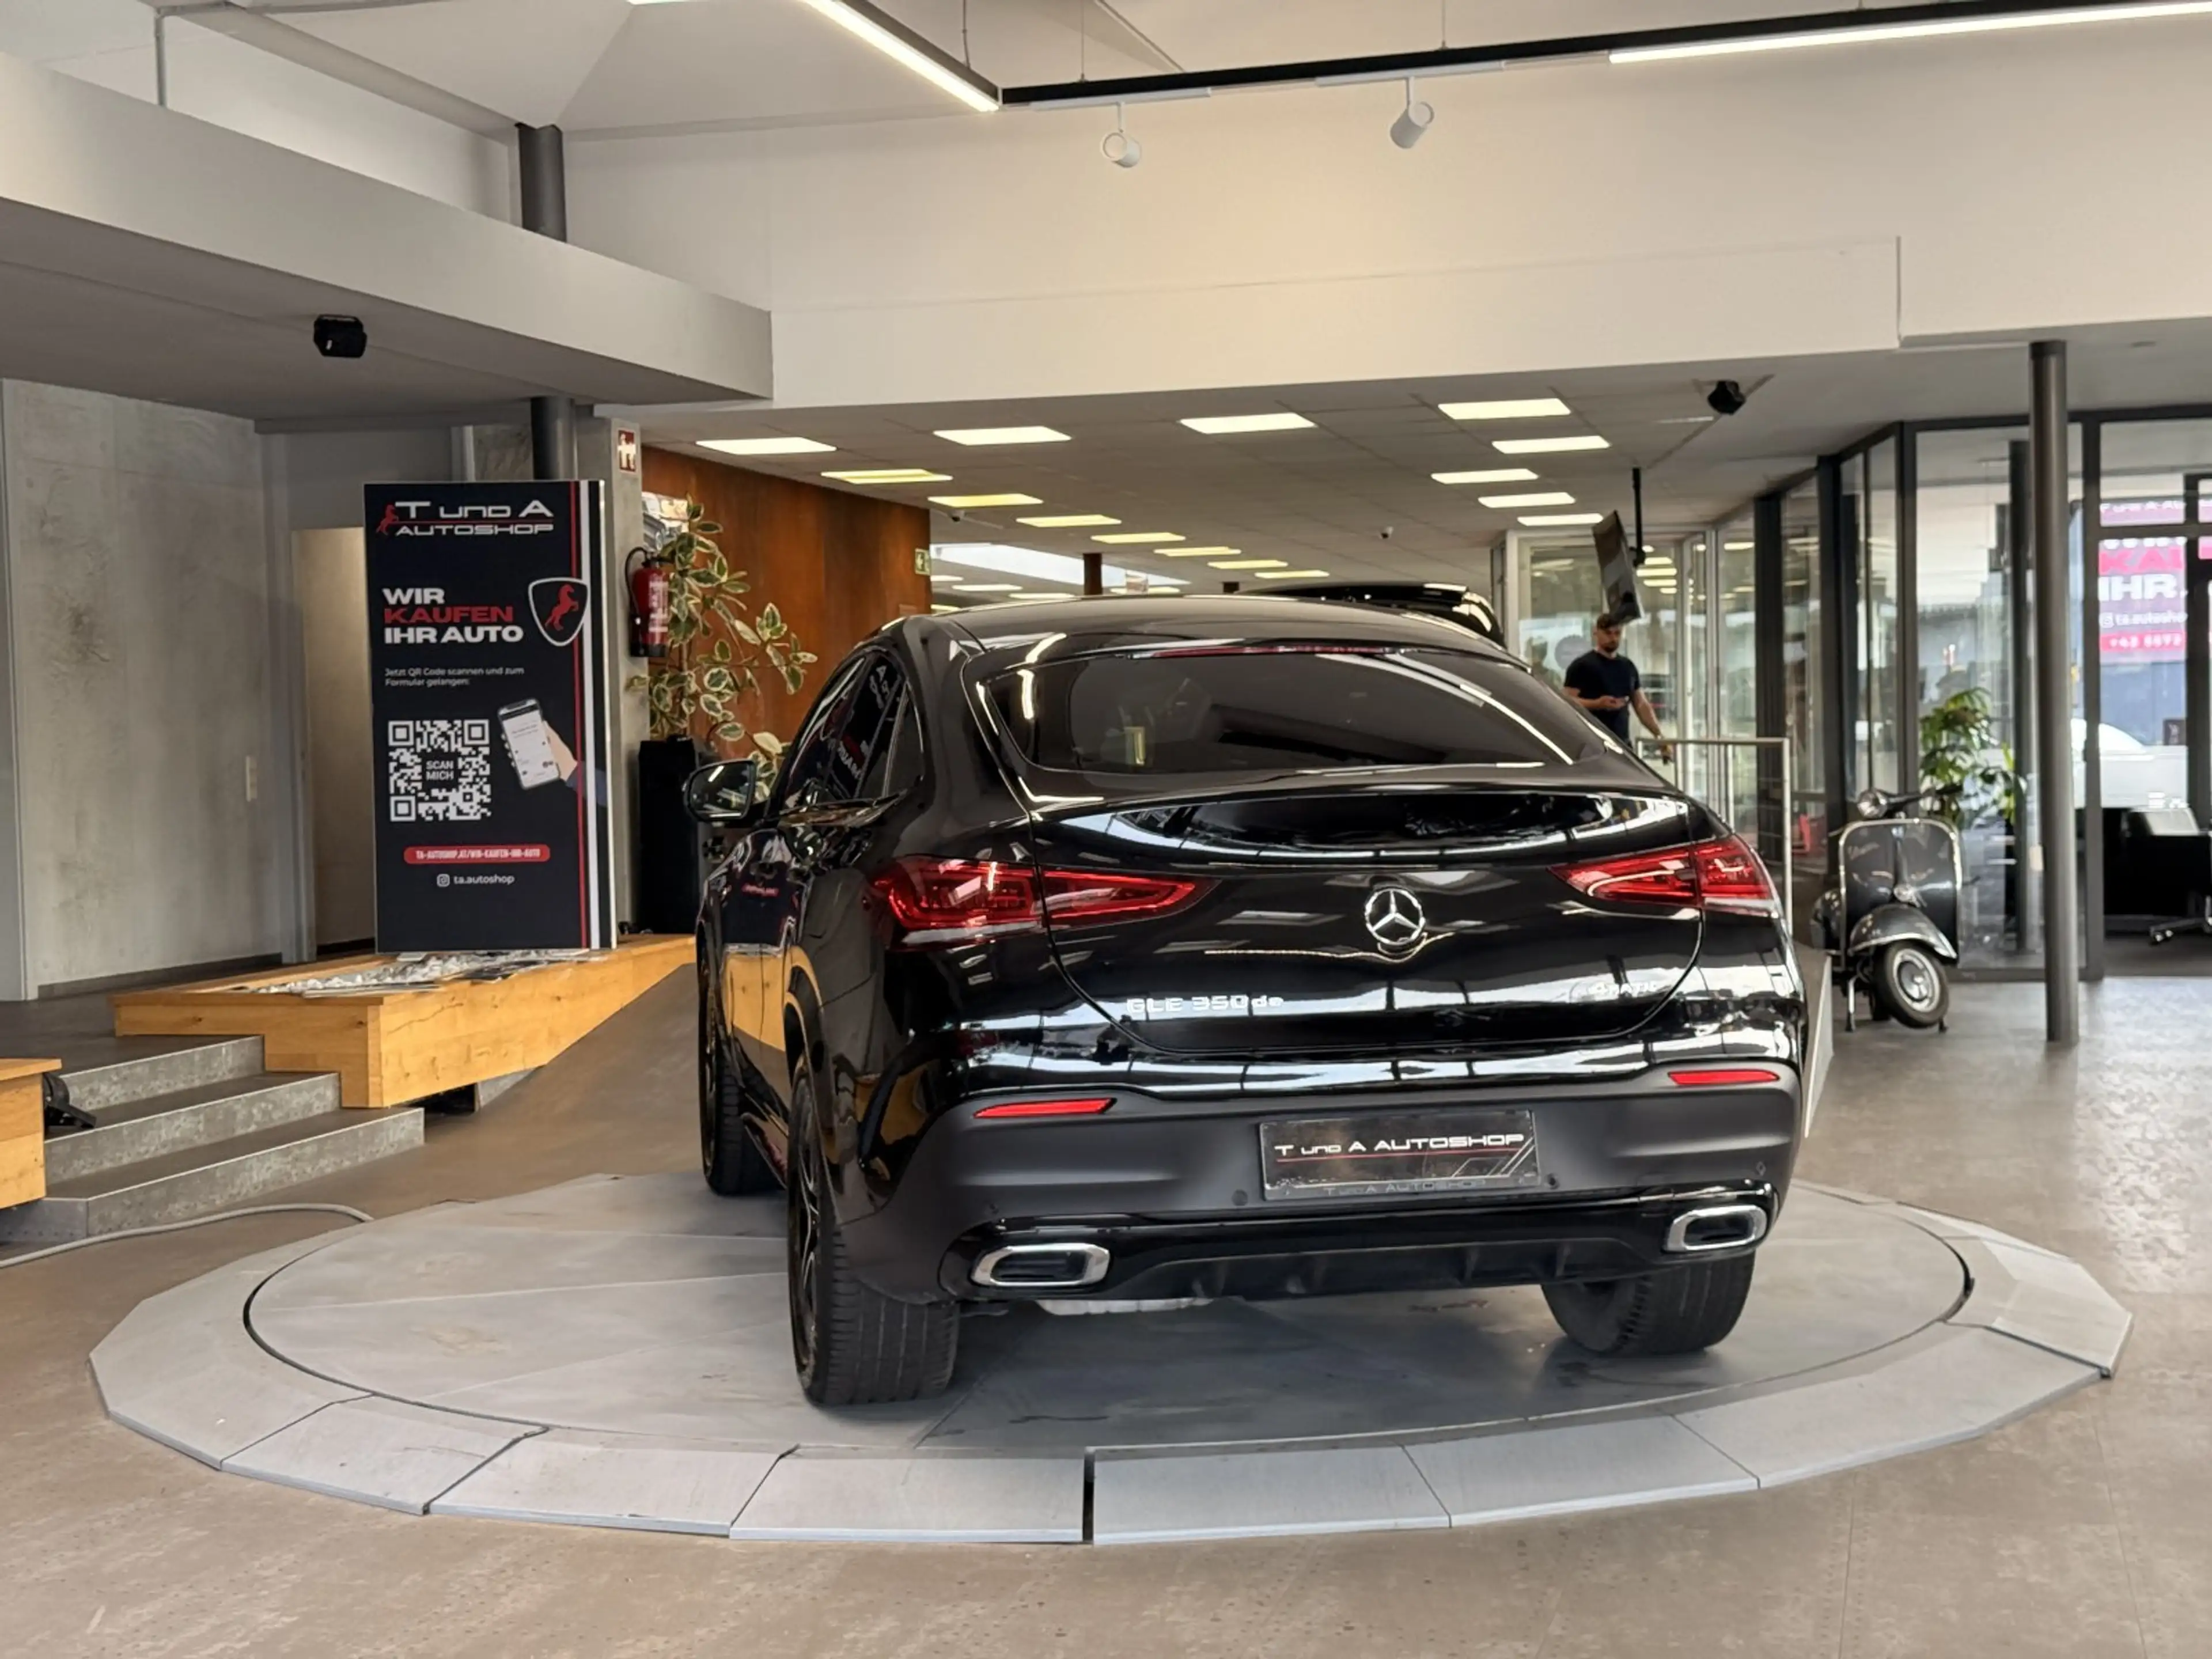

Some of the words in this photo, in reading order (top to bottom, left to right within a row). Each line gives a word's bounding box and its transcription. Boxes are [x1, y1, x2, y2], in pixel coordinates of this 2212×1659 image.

[395, 501, 431, 518] T
[518, 499, 554, 517] A
[395, 524, 554, 536] AUTOSHOP
[2098, 574, 2177, 601] IHR
[382, 588, 445, 605] WIR
[384, 606, 514, 624] KAUFEN
[385, 627, 438, 644] IHR
[441, 626, 524, 643] AUTO
[408, 668, 422, 676] QR
[423, 668, 446, 676] Code
[448, 668, 484, 676] scannen
[486, 667, 503, 675] und
[505, 668, 524, 676] zum
[385, 678, 425, 686] Formular
[426, 760, 454, 770] SCAN
[426, 771, 454, 781] MICH
[454, 874, 515, 885] ta.autoshop
[1127, 997, 1183, 1013] GLE
[1274, 1145, 1294, 1156] T
[1349, 1141, 1367, 1153] A
[1374, 1134, 1525, 1152] AUTOSHOP
[1385, 1179, 1486, 1194] AUTOSHOP
